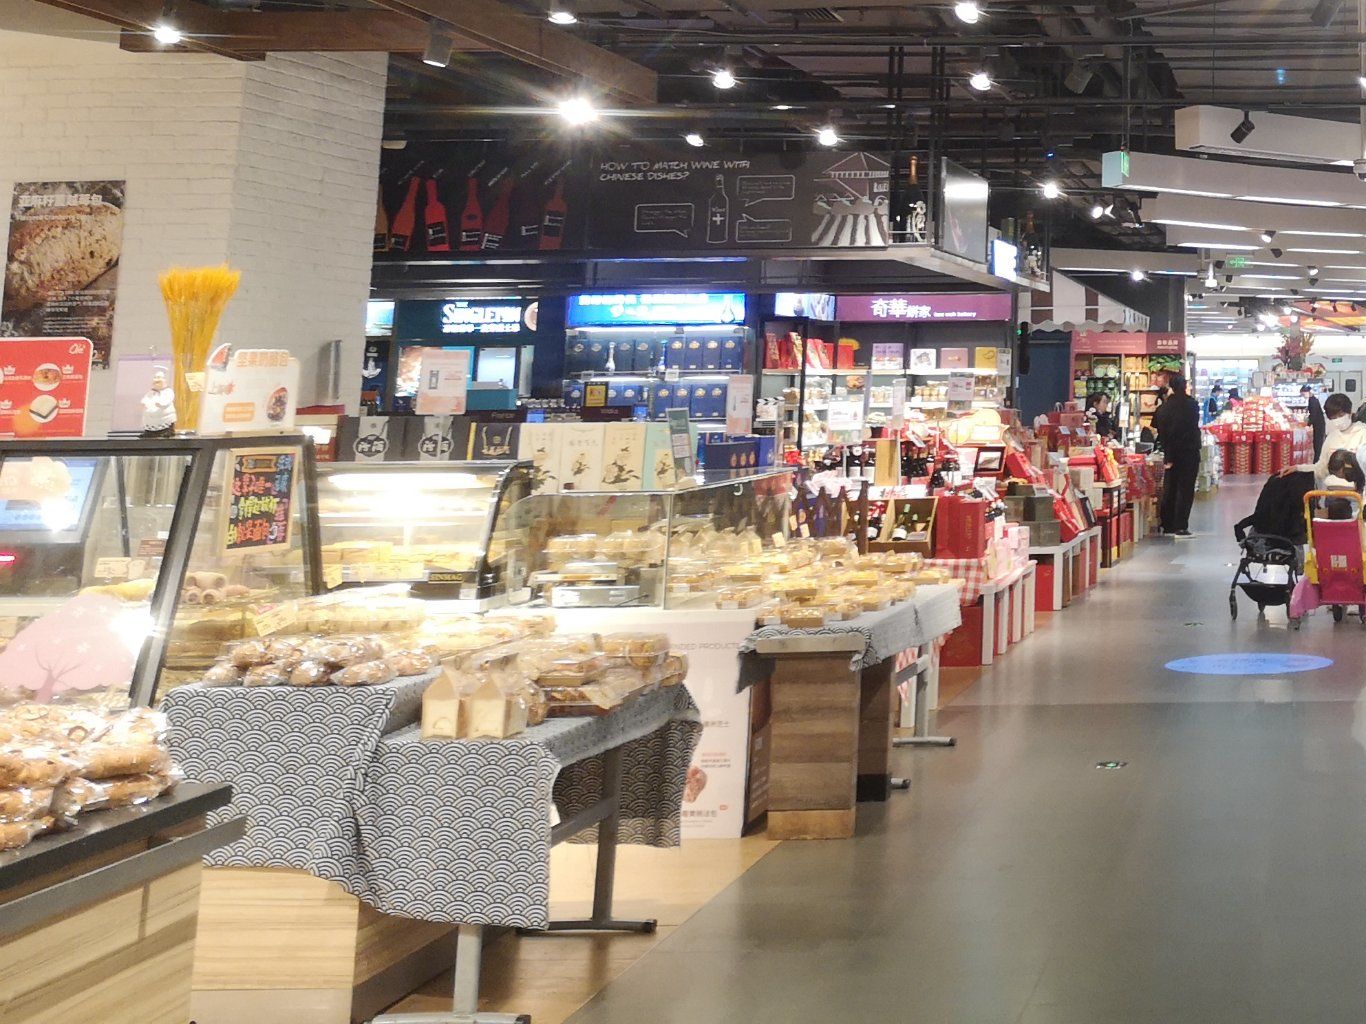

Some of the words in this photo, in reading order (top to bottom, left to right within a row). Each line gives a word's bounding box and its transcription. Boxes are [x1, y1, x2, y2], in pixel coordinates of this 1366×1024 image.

[600, 161, 628, 171] HOW
[631, 161, 650, 171] TO
[653, 161, 688, 171] MATCH
[691, 160, 721, 169] WINE
[723, 160, 751, 169] WITH
[600, 172, 644, 181] CHINESE
[647, 171, 690, 181] DISHES?
